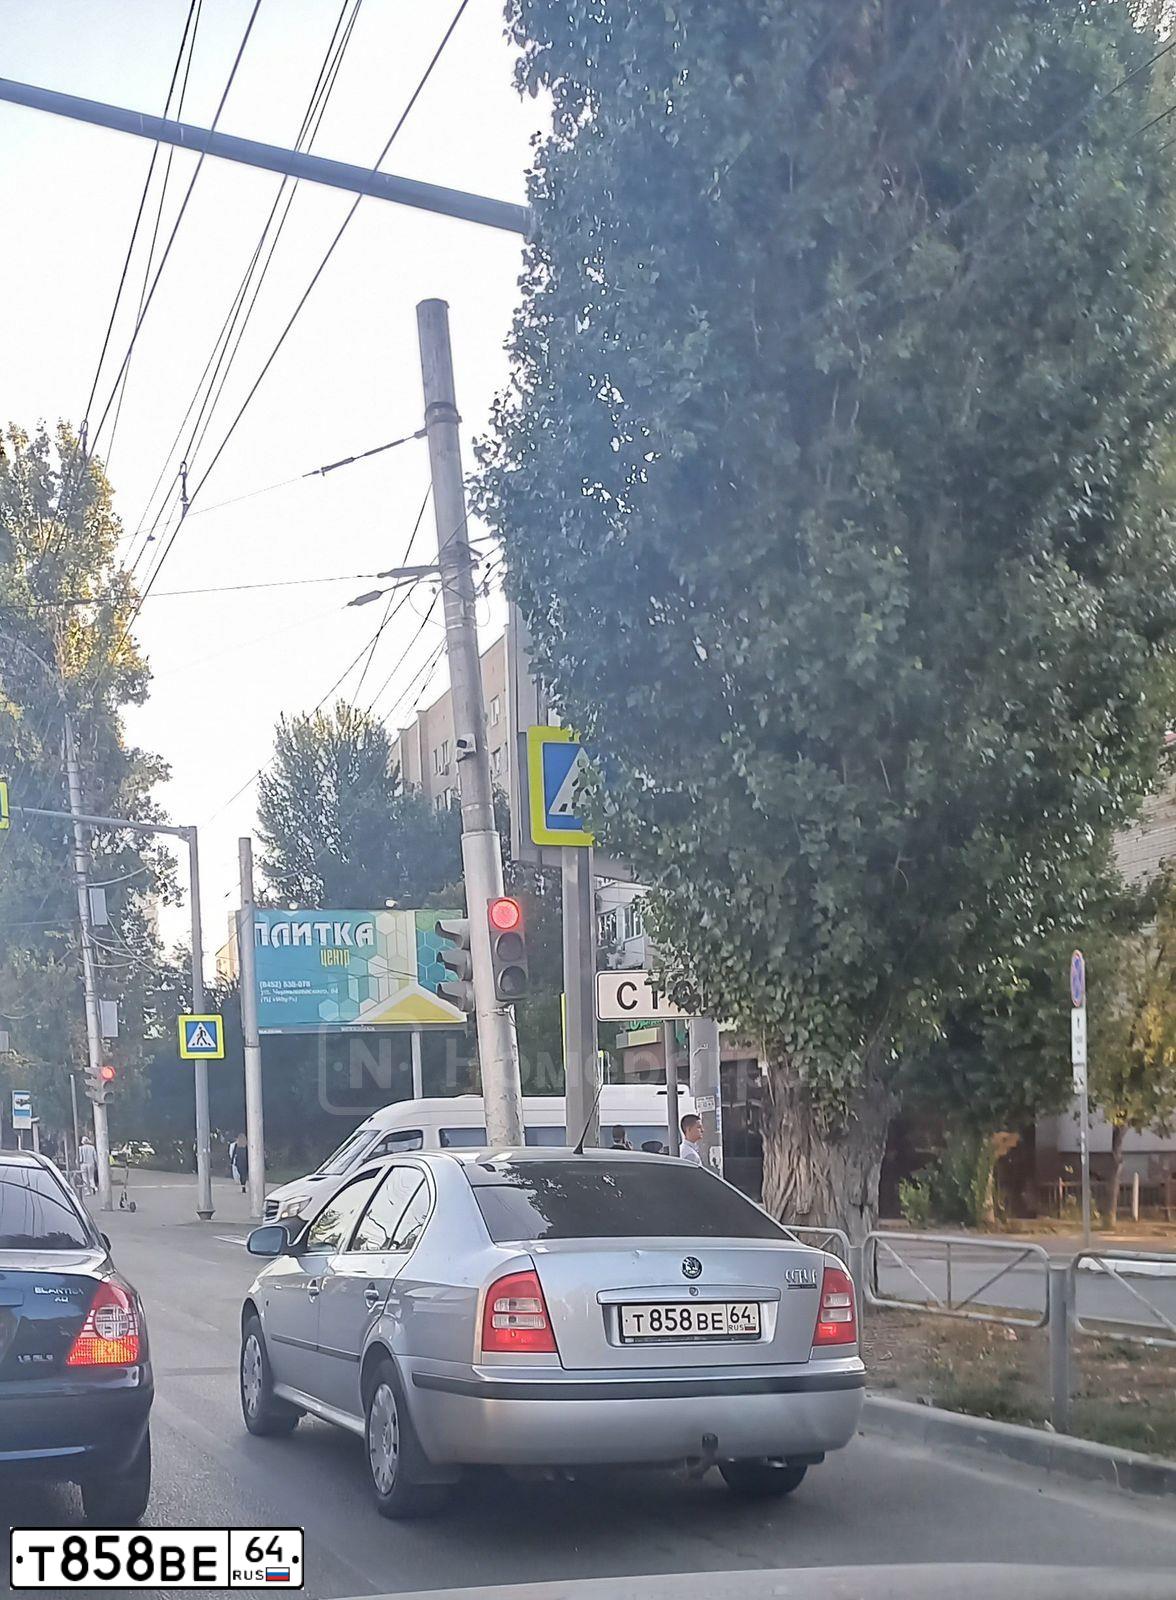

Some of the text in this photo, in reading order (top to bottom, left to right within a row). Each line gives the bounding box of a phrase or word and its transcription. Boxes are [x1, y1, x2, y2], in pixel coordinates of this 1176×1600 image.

[254, 922, 374, 948] ПЛИТКА
[729, 1306, 751, 1324] 64
[728, 1324, 744, 1332] RUS
